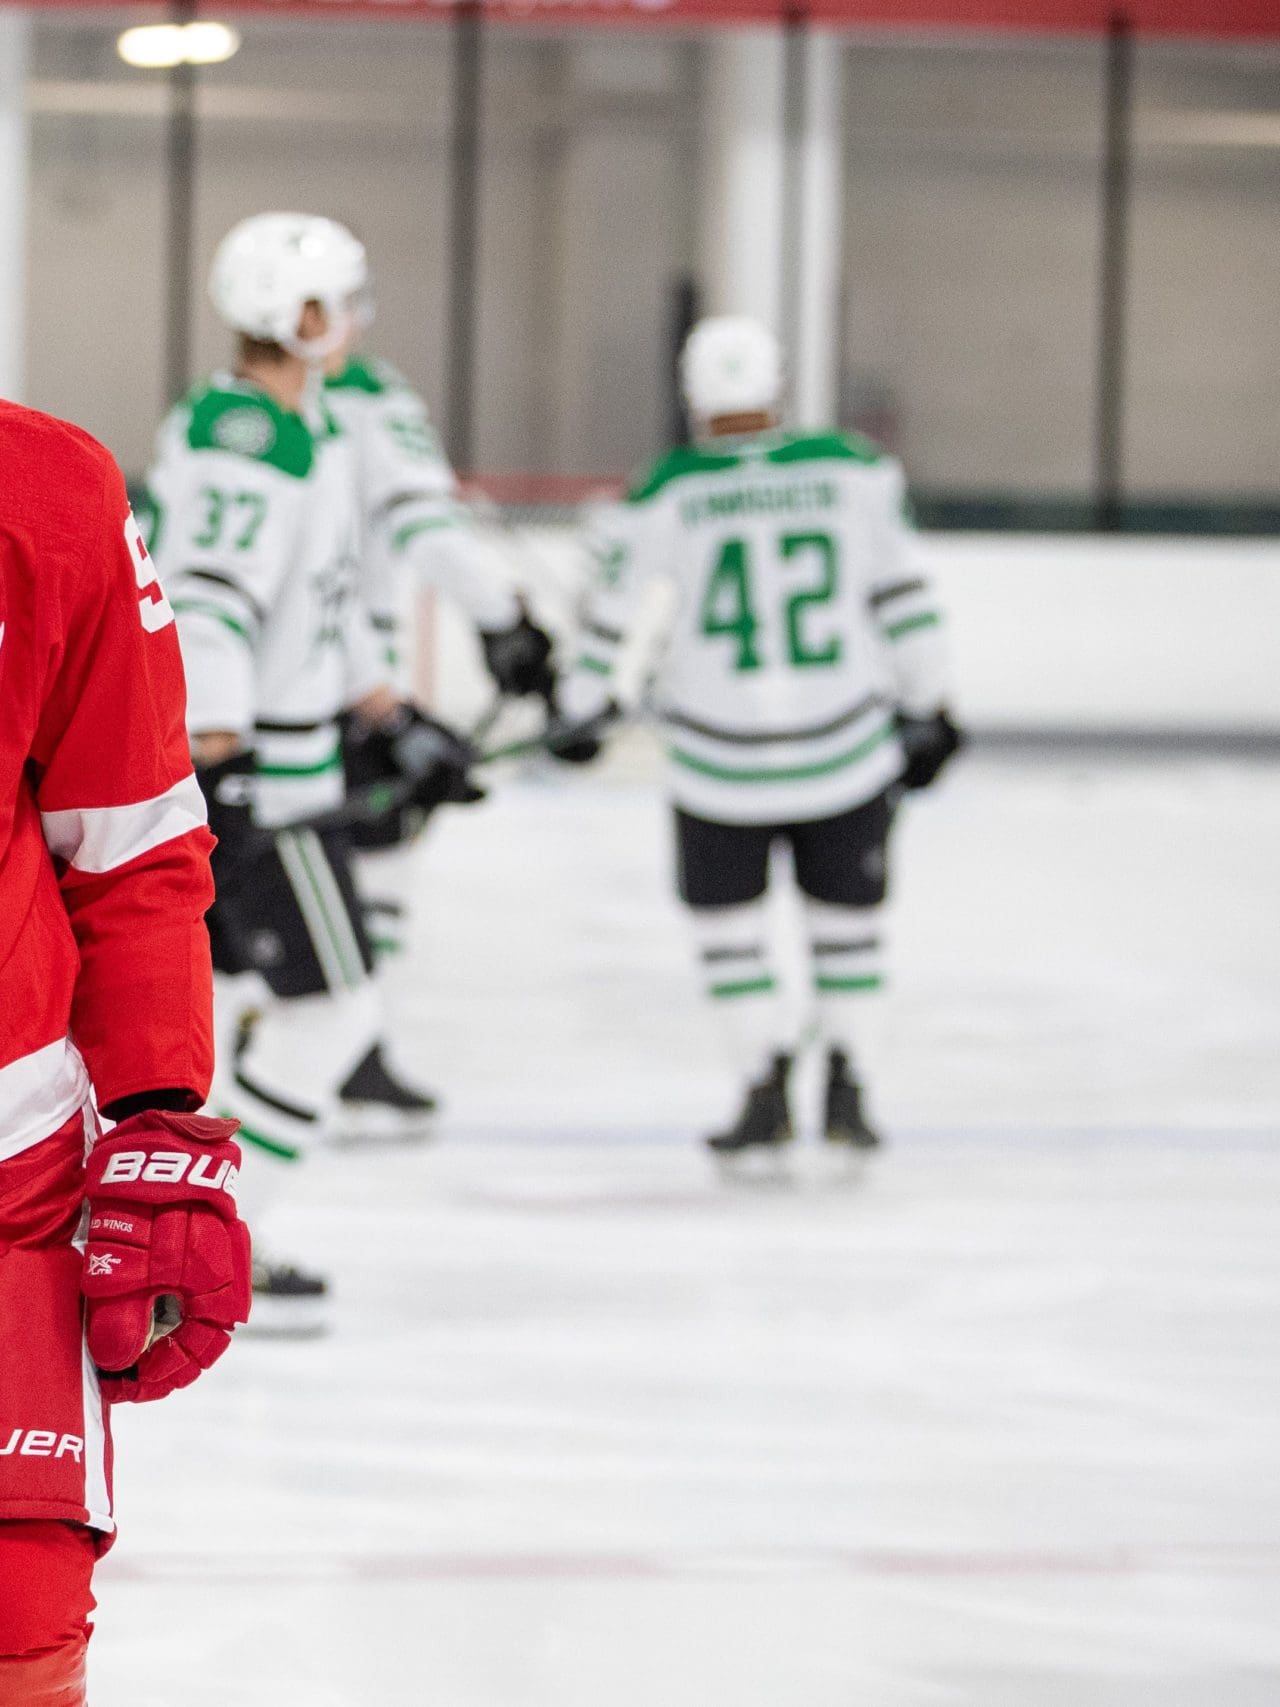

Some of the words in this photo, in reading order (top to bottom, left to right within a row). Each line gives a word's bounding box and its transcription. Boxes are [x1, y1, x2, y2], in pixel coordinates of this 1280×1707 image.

[192, 487, 268, 550] 37
[702, 532, 842, 670] 42
[103, 1218, 133, 1233] WINGS
